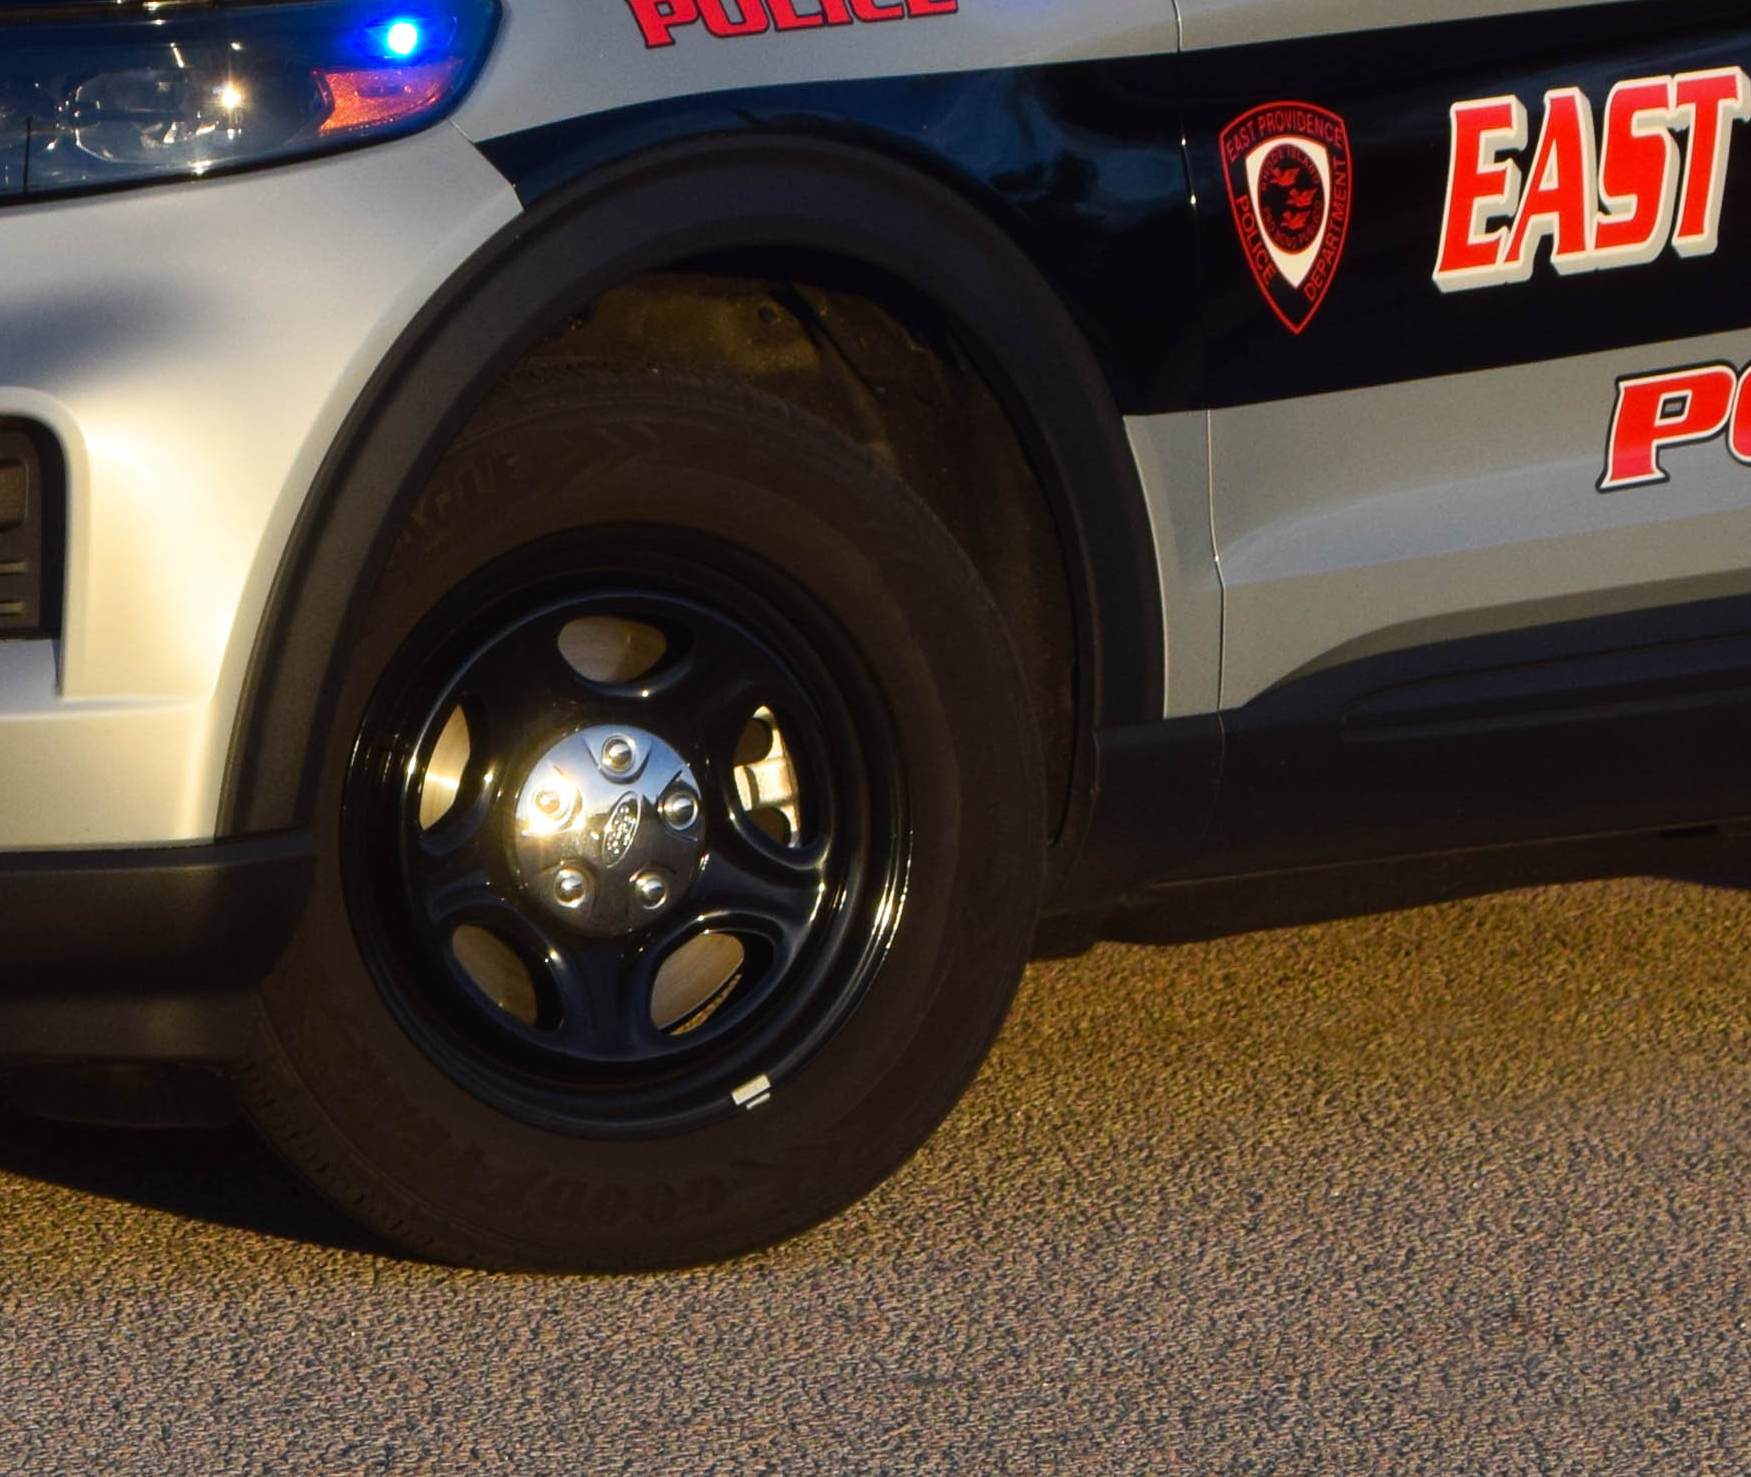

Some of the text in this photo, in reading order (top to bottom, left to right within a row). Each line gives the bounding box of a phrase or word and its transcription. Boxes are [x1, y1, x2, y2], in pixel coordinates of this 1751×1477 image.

[1225, 110, 1344, 163] EAST PROVIDENCE
[1235, 194, 1277, 287] POLICE
[1303, 156, 1348, 302] DEPARTMENT
